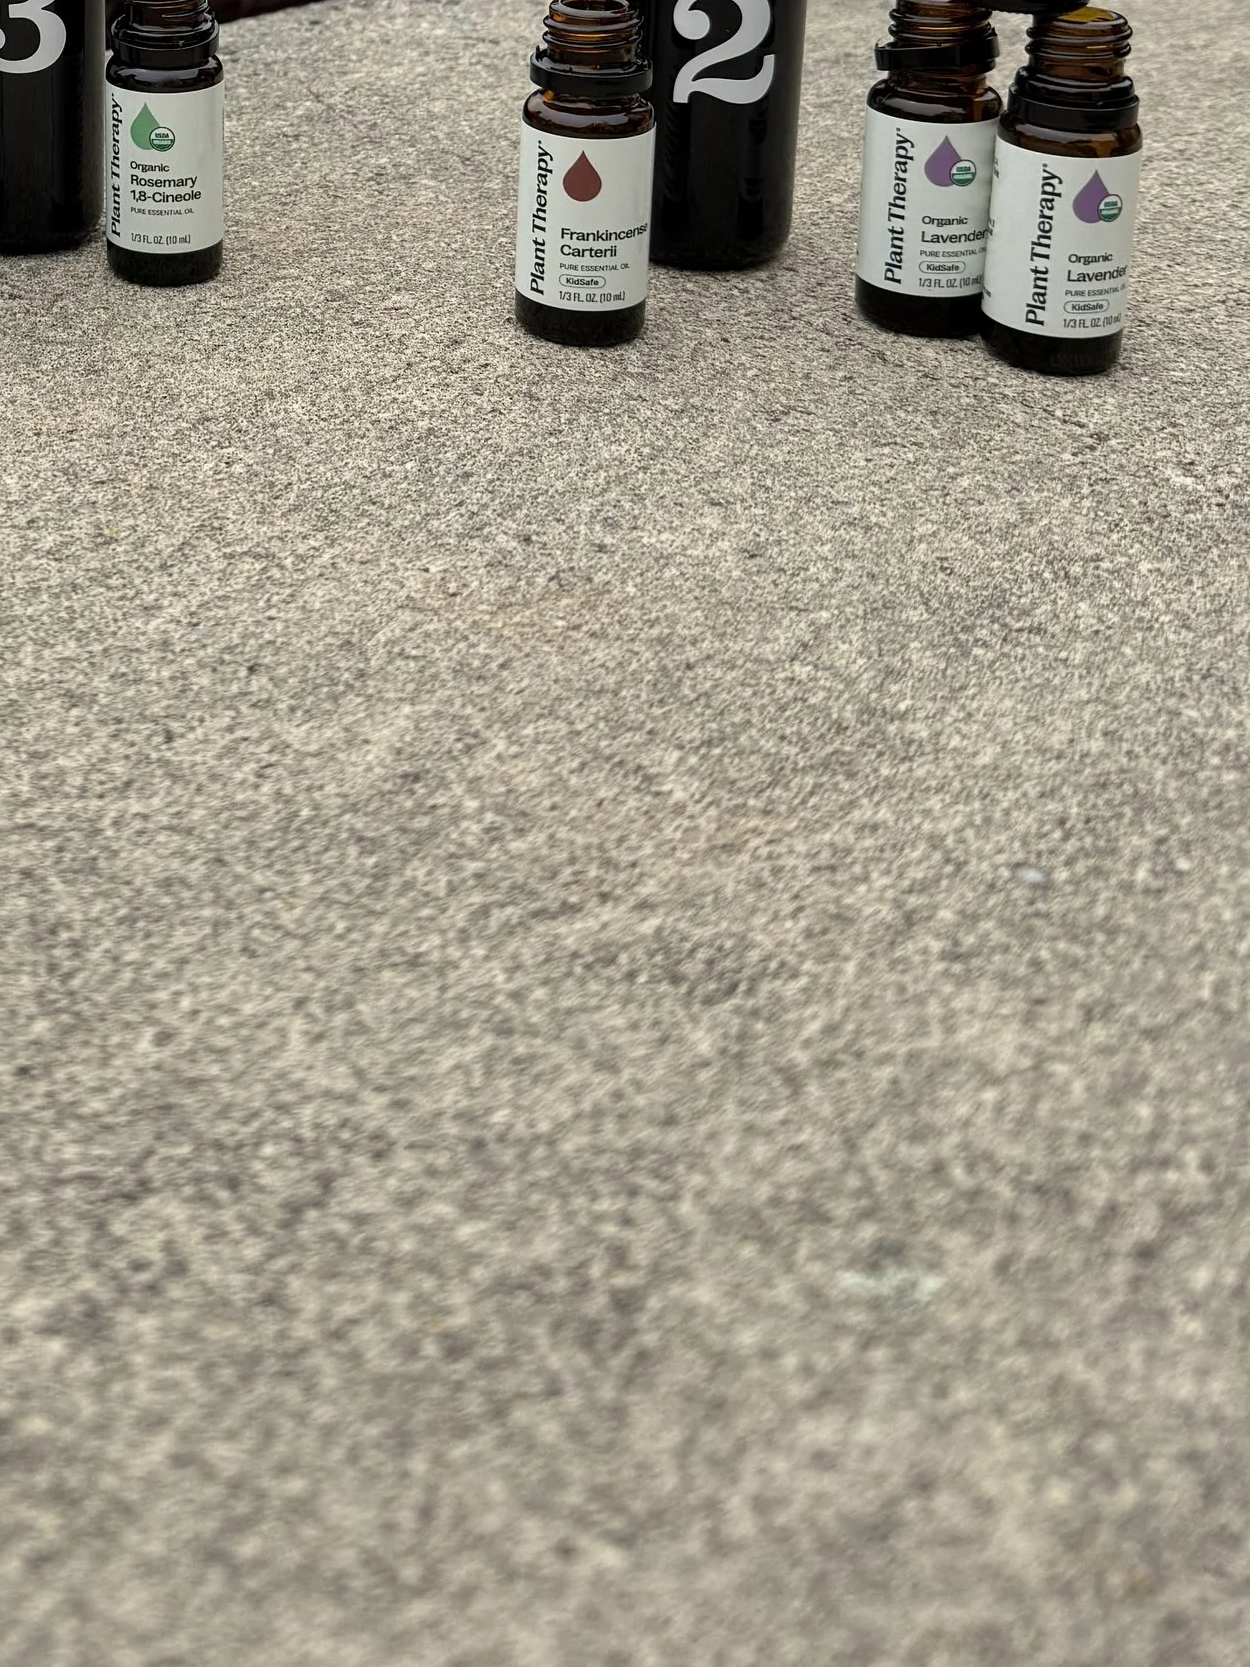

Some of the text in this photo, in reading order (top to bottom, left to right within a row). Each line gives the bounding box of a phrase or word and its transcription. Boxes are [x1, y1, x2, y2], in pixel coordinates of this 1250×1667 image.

[111, 96, 123, 237] Plant Therapy
[130, 160, 170, 173] Organic
[130, 174, 198, 188] Rosemary
[130, 190, 202, 203] 1,8-Cineole
[130, 207, 194, 216] PURE ESSENTIAL OIL
[884, 133, 914, 285] Plant Therapy
[530, 145, 554, 295] Plant Therapy
[922, 215, 968, 228] Organic
[131, 233, 142, 243] 1/3
[142, 235, 152, 244] FL.
[153, 235, 164, 244] OZ.
[166, 235, 177, 246] (10
[921, 228, 988, 244] Lavender
[560, 244, 617, 258] Carterii
[920, 249, 940, 257] PURE
[942, 249, 978, 258] ESSENTIAL
[1025, 168, 1063, 326] Plant Therapy
[1068, 253, 1113, 266] Organic
[559, 262, 630, 272] PURE ESSENTIAL OIL
[926, 263, 960, 272] KidSafe
[1067, 265, 1128, 283] Lavender
[565, 277, 600, 286] KidSafe
[919, 278, 932, 288] 1/3
[934, 278, 945, 288] FL.
[960, 277, 970, 289] (10
[559, 291, 571, 301] 1/3
[573, 293, 584, 302] FL.
[585, 293, 598, 303] OZ.
[600, 293, 612, 304] (10
[1065, 289, 1086, 297] PURE
[1071, 302, 1104, 311] KidSafe
[1063, 318, 1077, 328] 1/3
[1078, 318, 1089, 328] FL.
[1103, 315, 1114, 328] (10
